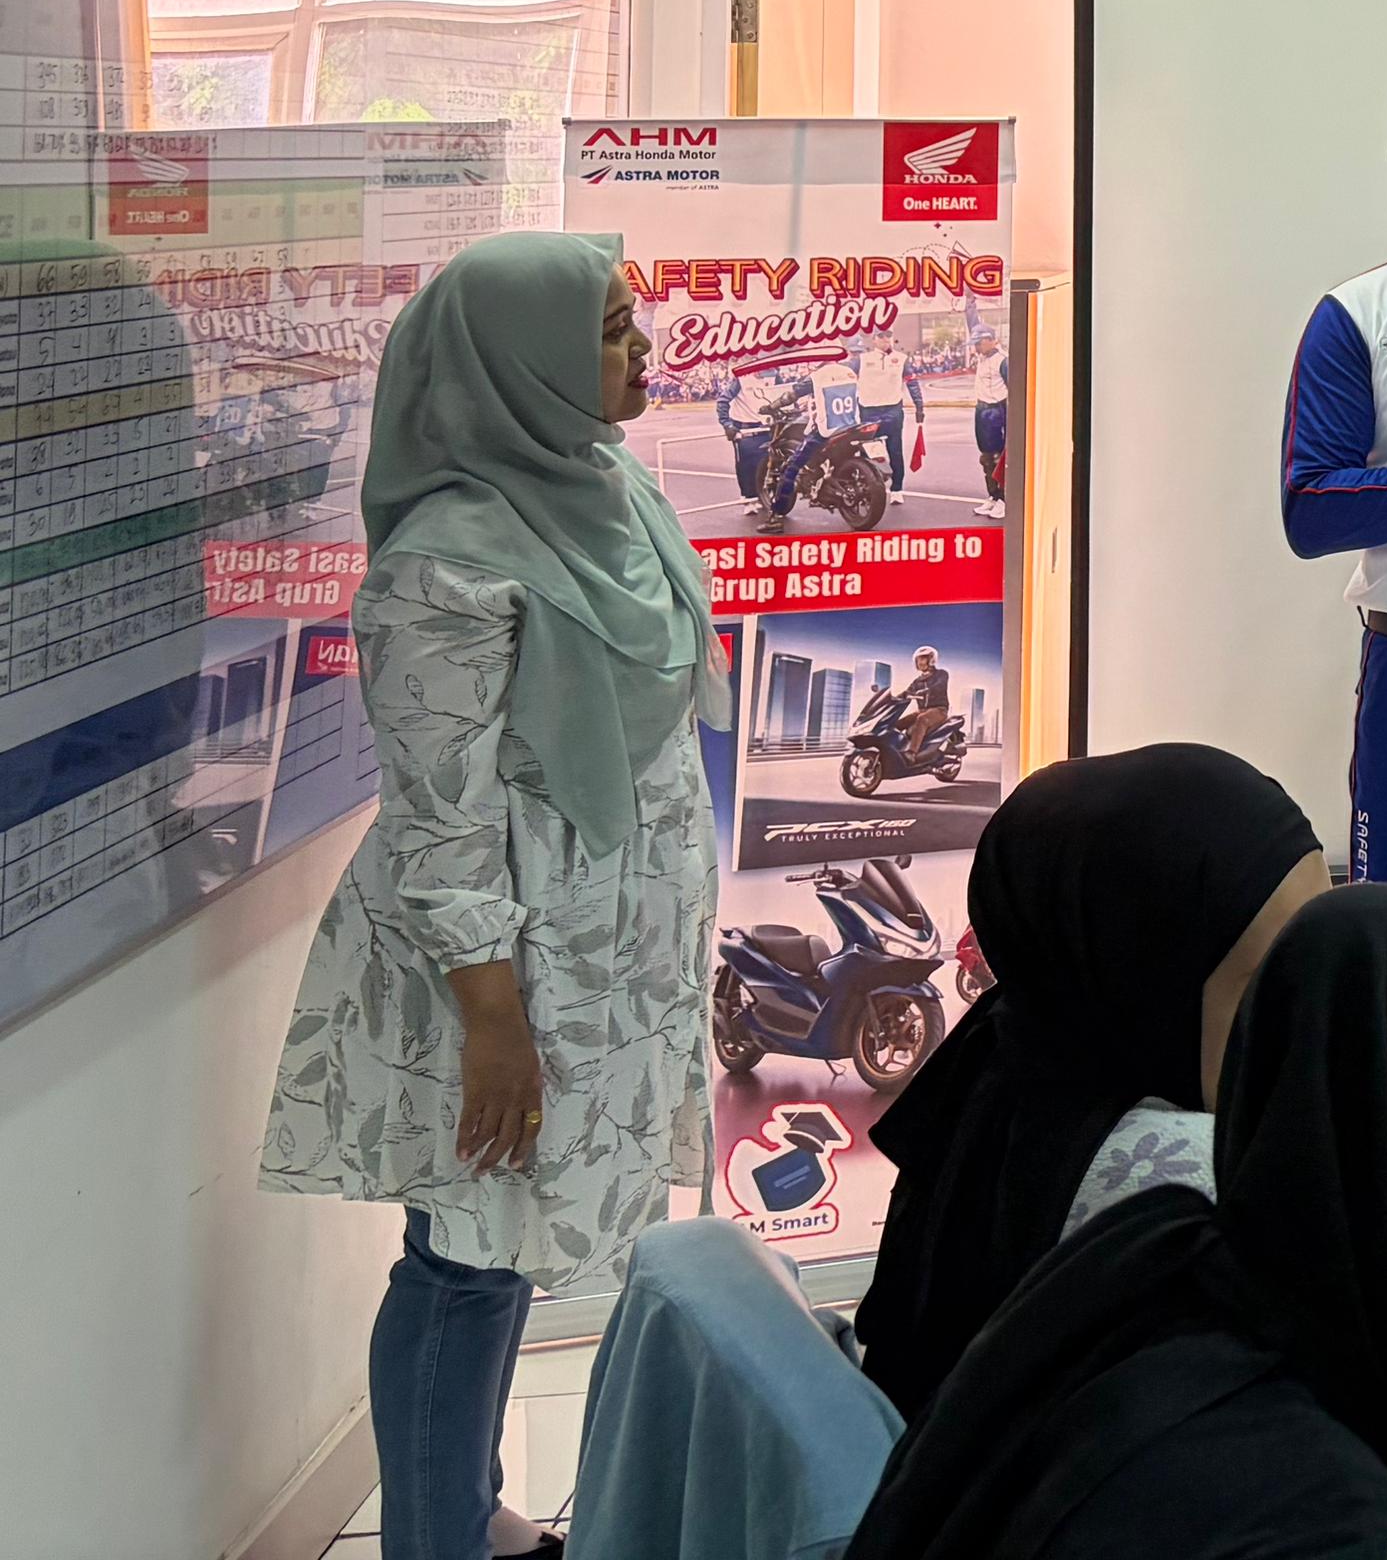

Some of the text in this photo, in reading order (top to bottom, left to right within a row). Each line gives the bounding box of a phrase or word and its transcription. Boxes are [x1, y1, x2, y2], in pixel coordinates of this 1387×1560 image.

[583, 128, 717, 146] AHM
[581, 149, 716, 160] PT Astra Honda Motor
[614, 170, 720, 181] ASTRA MOTOR
[904, 174, 978, 184] HONDA
[904, 197, 931, 211] One
[622, 255, 1004, 302] AFETY RIDING
[663, 296, 898, 371] Education
[832, 396, 854, 415] 09
[755, 541, 847, 570] Safety
[857, 535, 945, 564] Riding
[954, 534, 982, 558] to
[710, 573, 863, 603] Grup Astra
[781, 830, 906, 843] TRULY EXCEPTIONAL
[772, 1213, 829, 1231] Smart
